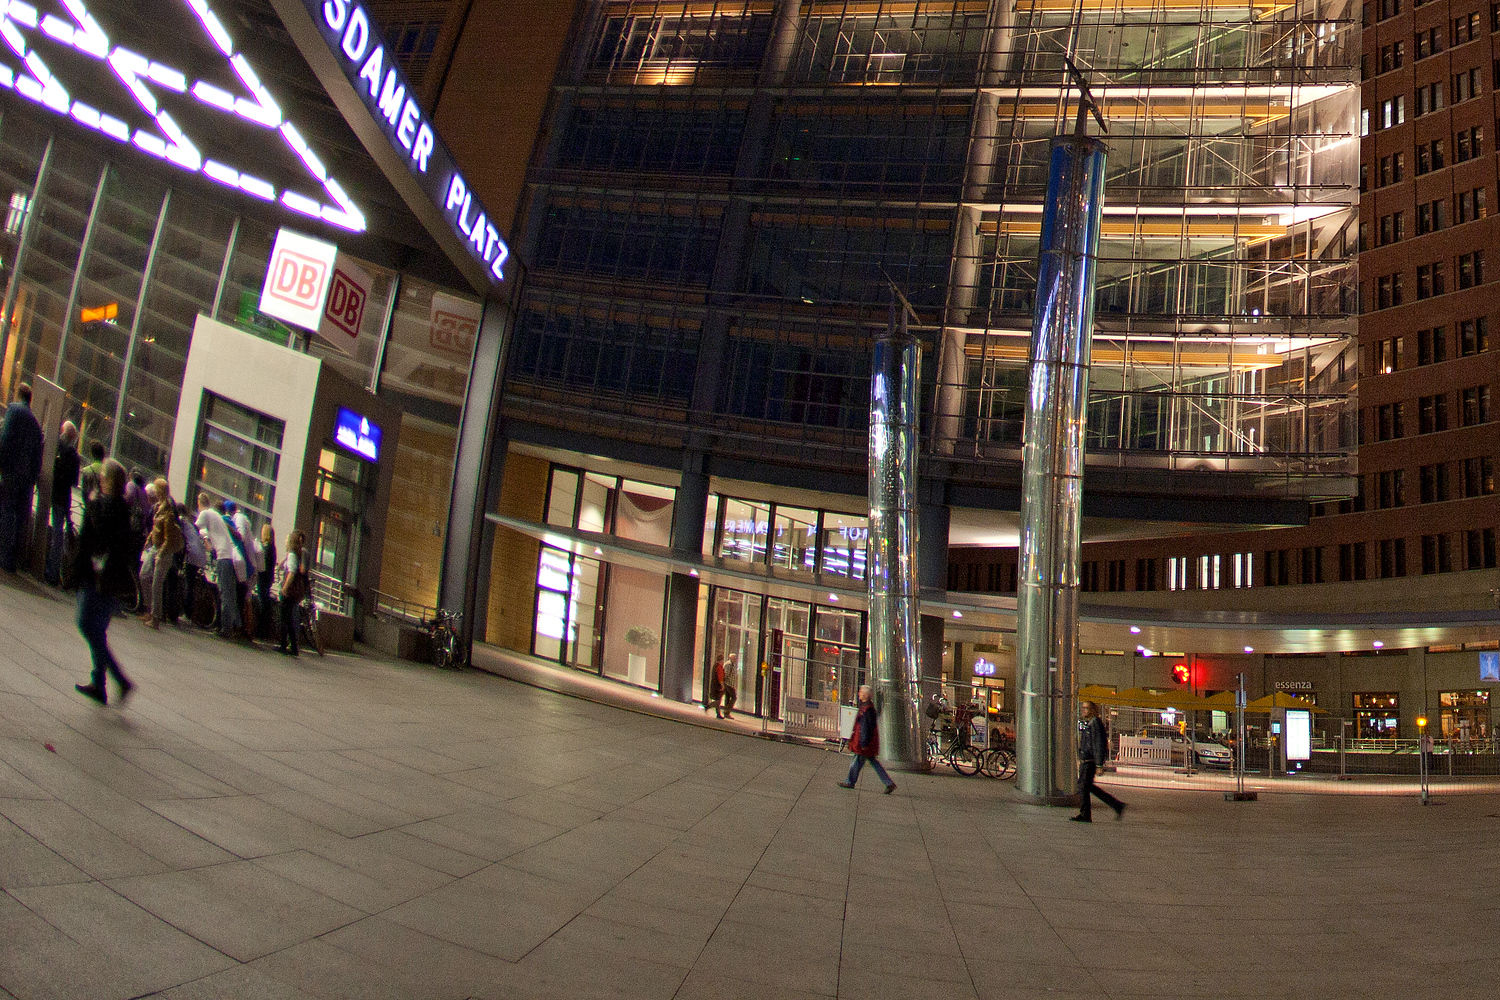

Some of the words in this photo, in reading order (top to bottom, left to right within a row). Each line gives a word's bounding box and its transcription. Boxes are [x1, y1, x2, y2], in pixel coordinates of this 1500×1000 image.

[446, 173, 510, 281] PLATZ
[276, 258, 318, 299] DB
[331, 279, 361, 327] DB
[1275, 681, 1312, 689] essenza
